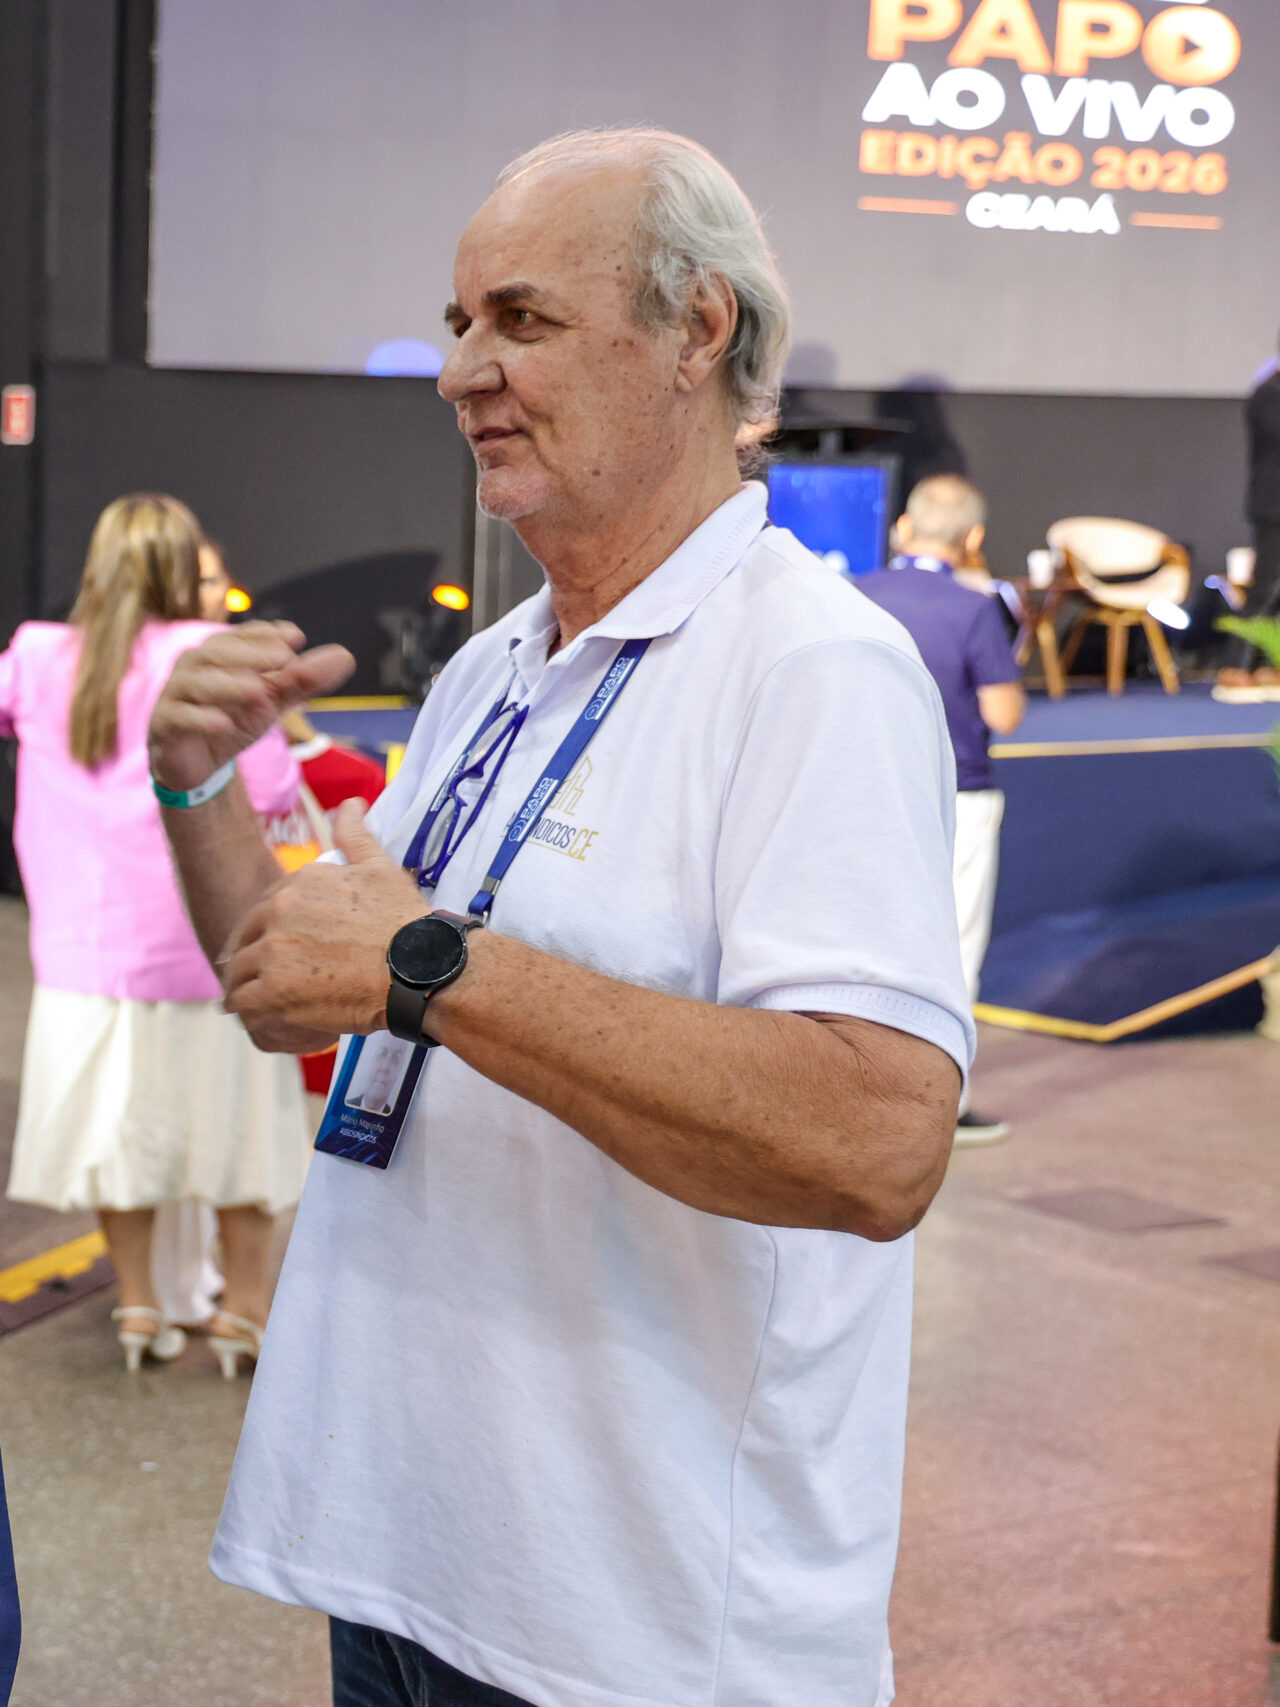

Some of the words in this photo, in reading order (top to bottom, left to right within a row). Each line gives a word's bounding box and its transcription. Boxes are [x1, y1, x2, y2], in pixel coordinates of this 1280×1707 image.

[867, 0, 1241, 87] PAPO
[861, 62, 1006, 131] AO
[1020, 74, 1235, 147] VIVO
[859, 129, 1083, 190] EDIÇÃO
[1090, 146, 1228, 195] 2026
